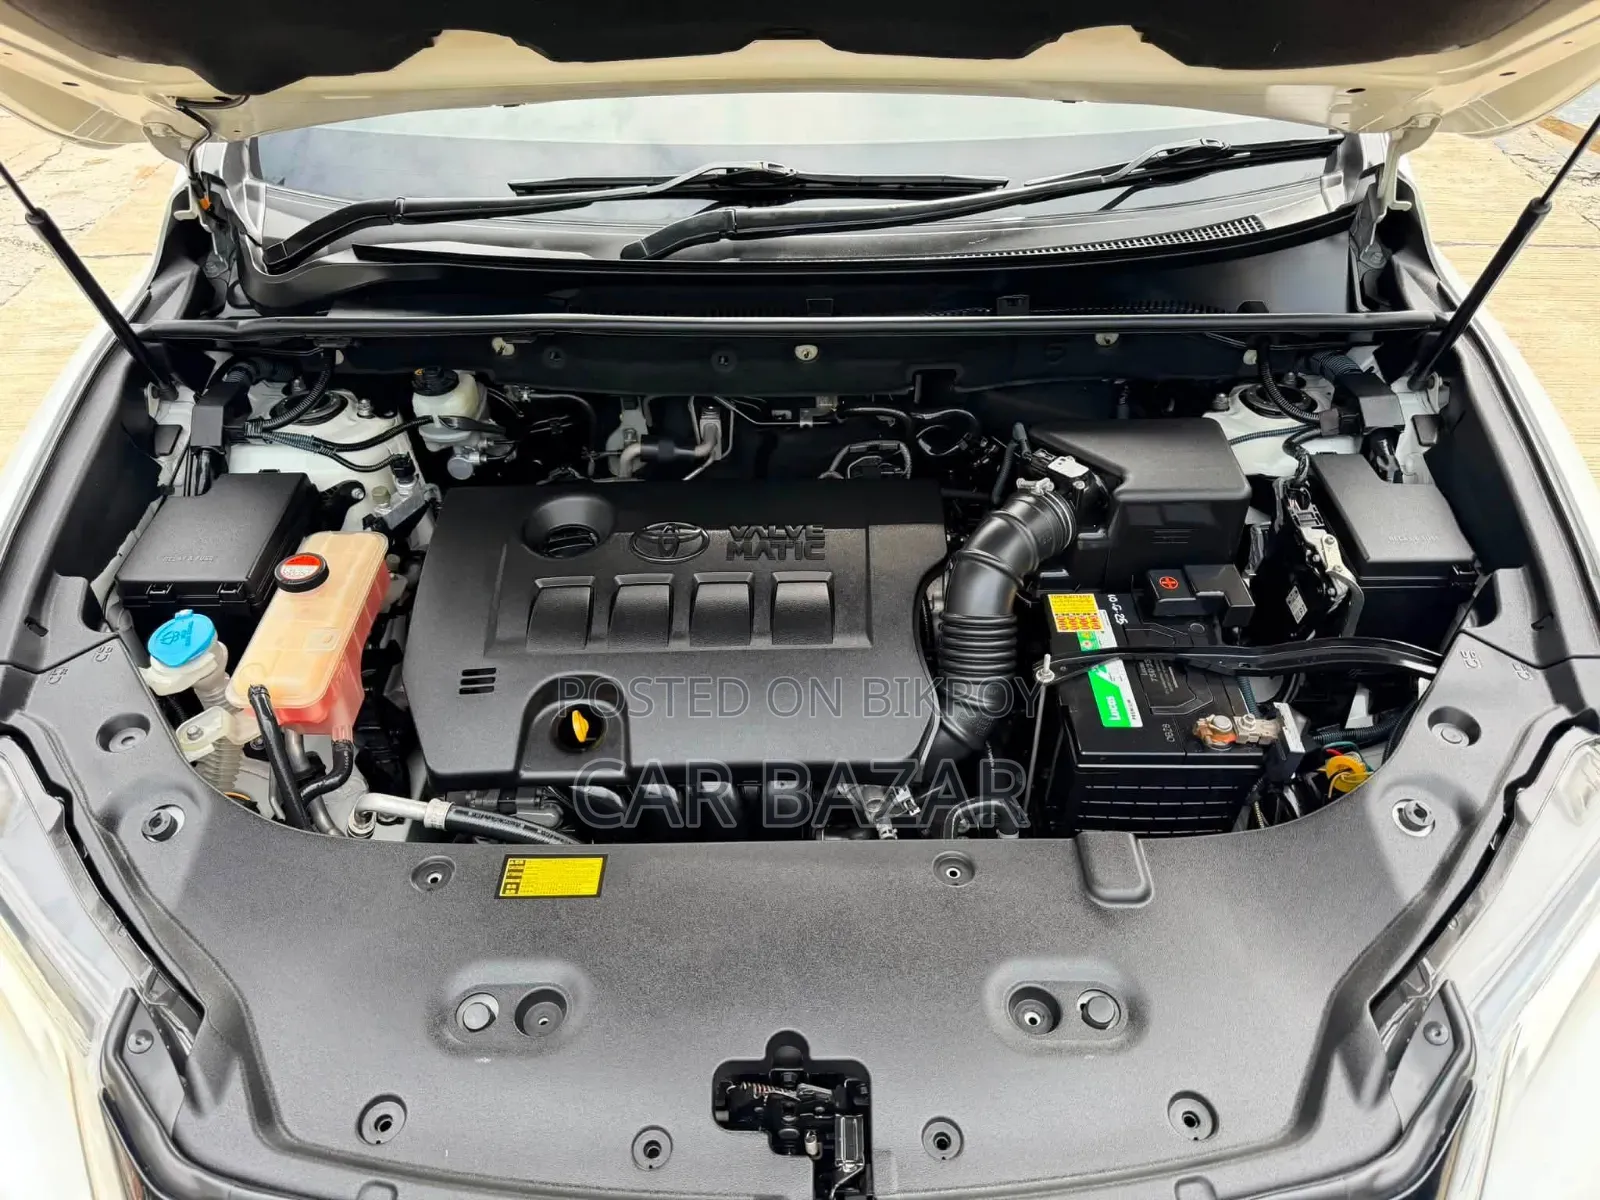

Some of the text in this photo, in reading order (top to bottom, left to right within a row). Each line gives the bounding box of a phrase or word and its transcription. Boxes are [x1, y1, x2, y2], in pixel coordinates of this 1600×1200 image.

[728, 524, 825, 540] VALVE
[725, 540, 826, 561] MATIC
[1105, 695, 1122, 721] Lucas
